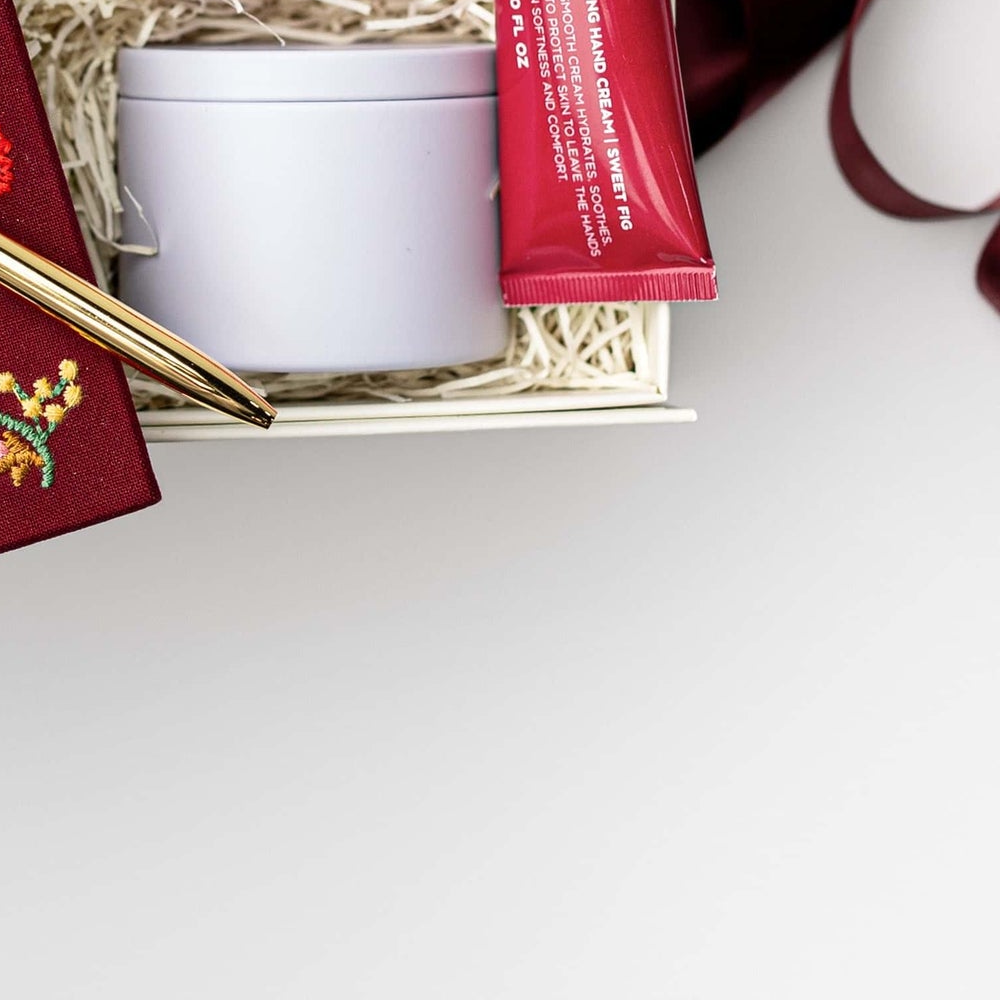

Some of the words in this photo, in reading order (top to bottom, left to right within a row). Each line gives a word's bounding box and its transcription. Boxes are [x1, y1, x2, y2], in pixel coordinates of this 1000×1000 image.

[512, 14, 524, 37] FL
[515, 42, 529, 68] OZ
[532, 7, 550, 78] SOFTNESS
[542, 82, 555, 111] AND
[548, 18, 566, 80] PROTECT
[589, 27, 606, 73] HAND
[557, 85, 571, 115] SKIN
[568, 56, 584, 105] CREAM
[597, 77, 615, 134] CREAM
[563, 118, 575, 137] TO
[566, 140, 583, 182] LEAVE
[607, 148, 627, 202] SWEET
[575, 186, 589, 211] THE
[617, 206, 633, 231] FIG
[581, 214, 601, 257] HANDS
